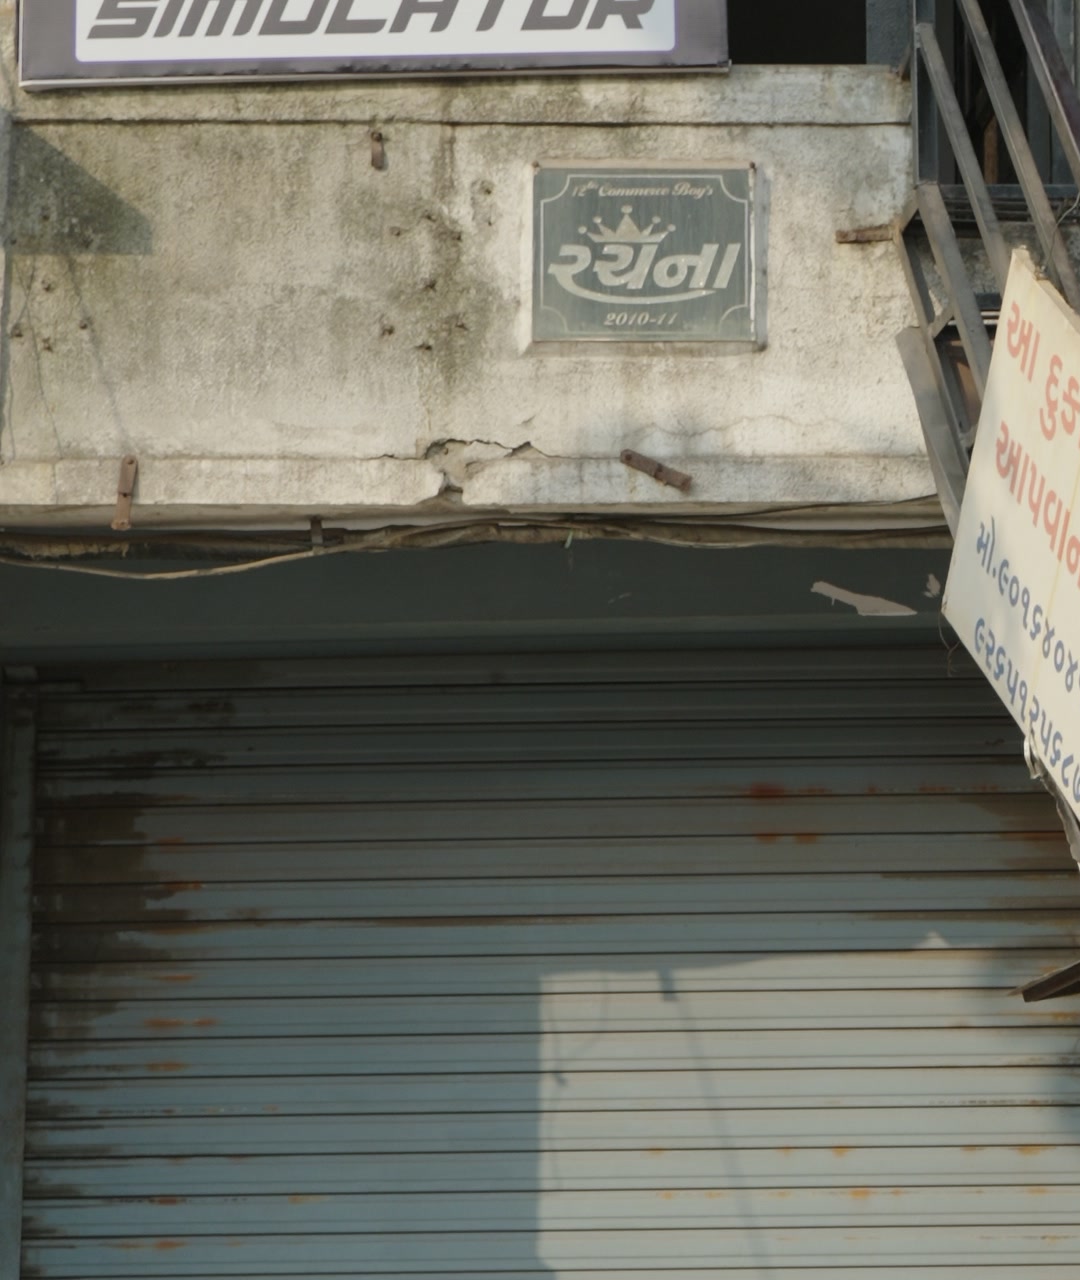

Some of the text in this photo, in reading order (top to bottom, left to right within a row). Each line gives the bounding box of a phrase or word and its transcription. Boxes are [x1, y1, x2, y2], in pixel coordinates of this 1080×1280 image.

[598, 183, 670, 197] Commerce
[603, 311, 679, 326] 2010-11
[1007, 301, 1041, 383] આ
